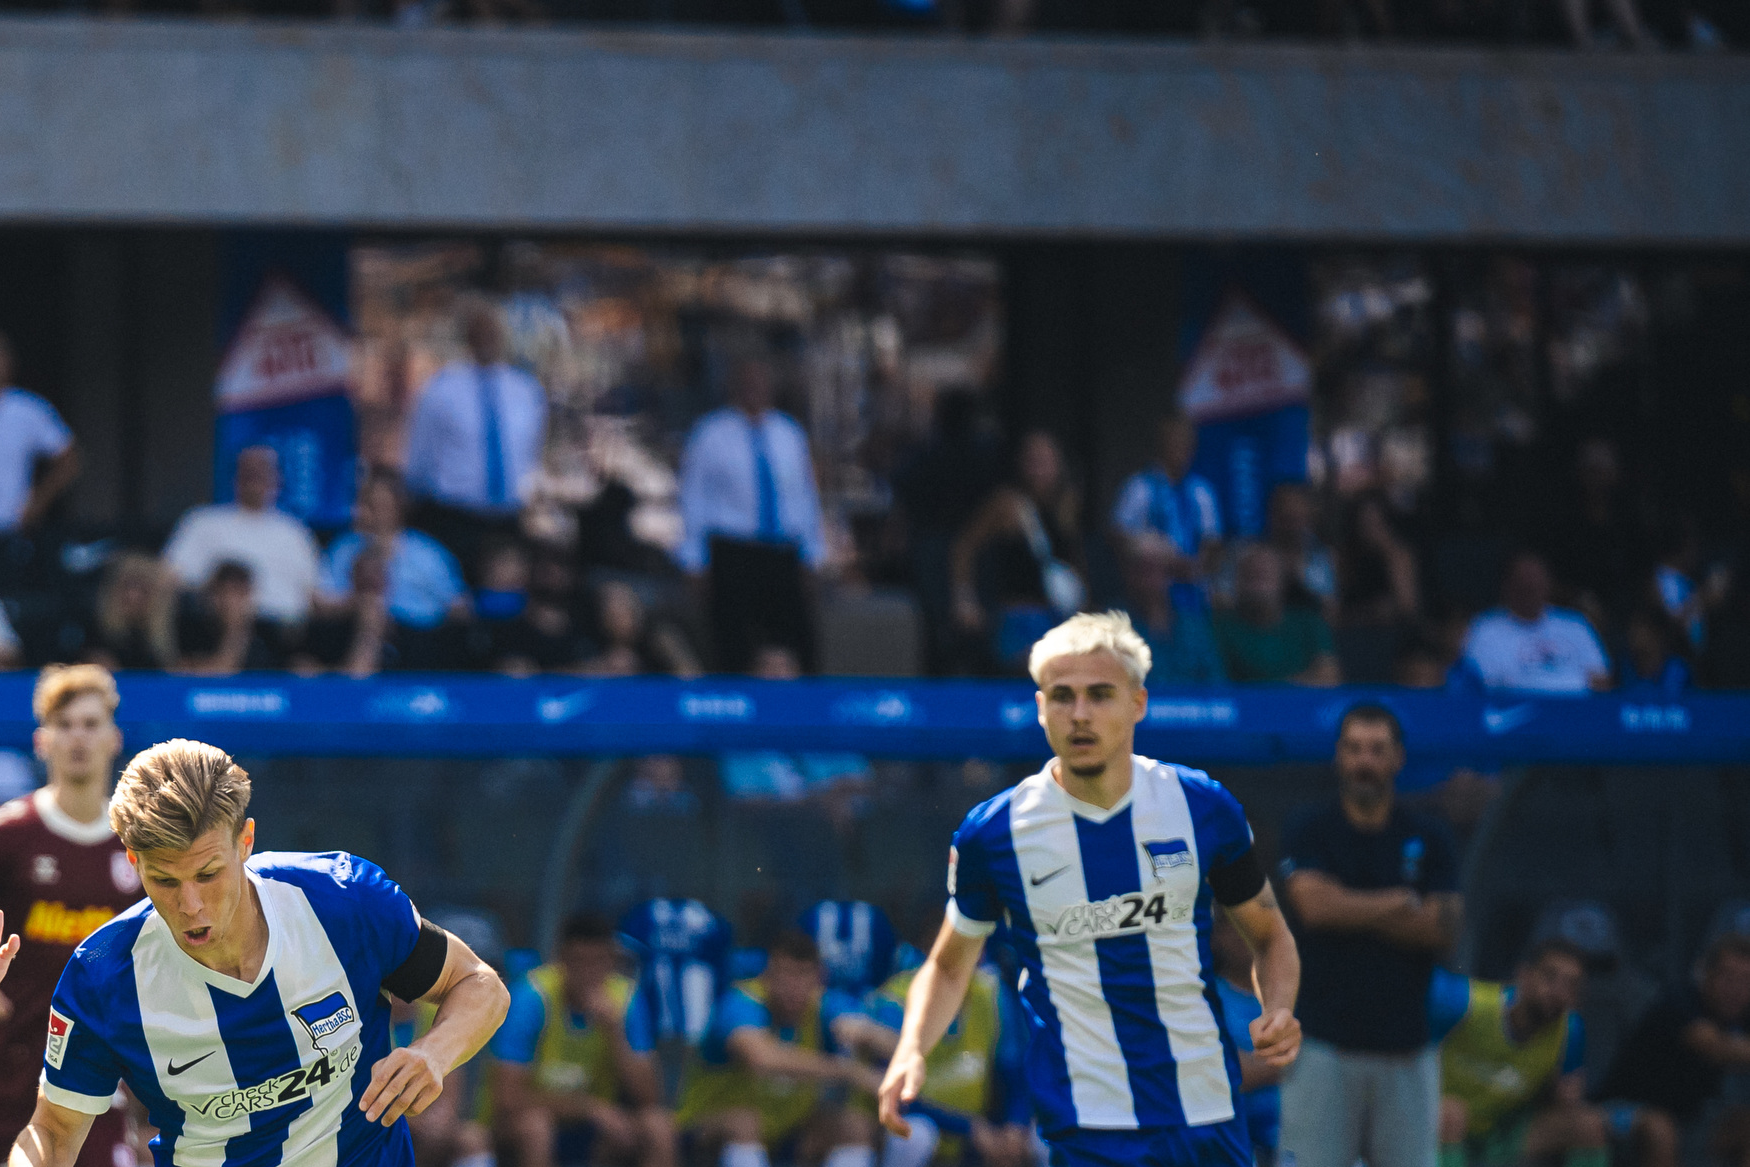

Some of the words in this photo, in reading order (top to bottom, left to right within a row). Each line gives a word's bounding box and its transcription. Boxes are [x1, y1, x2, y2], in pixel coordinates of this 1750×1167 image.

[1119, 892, 1167, 928] 24
[215, 1093, 275, 1119] CARS
[221, 1079, 279, 1107] check
